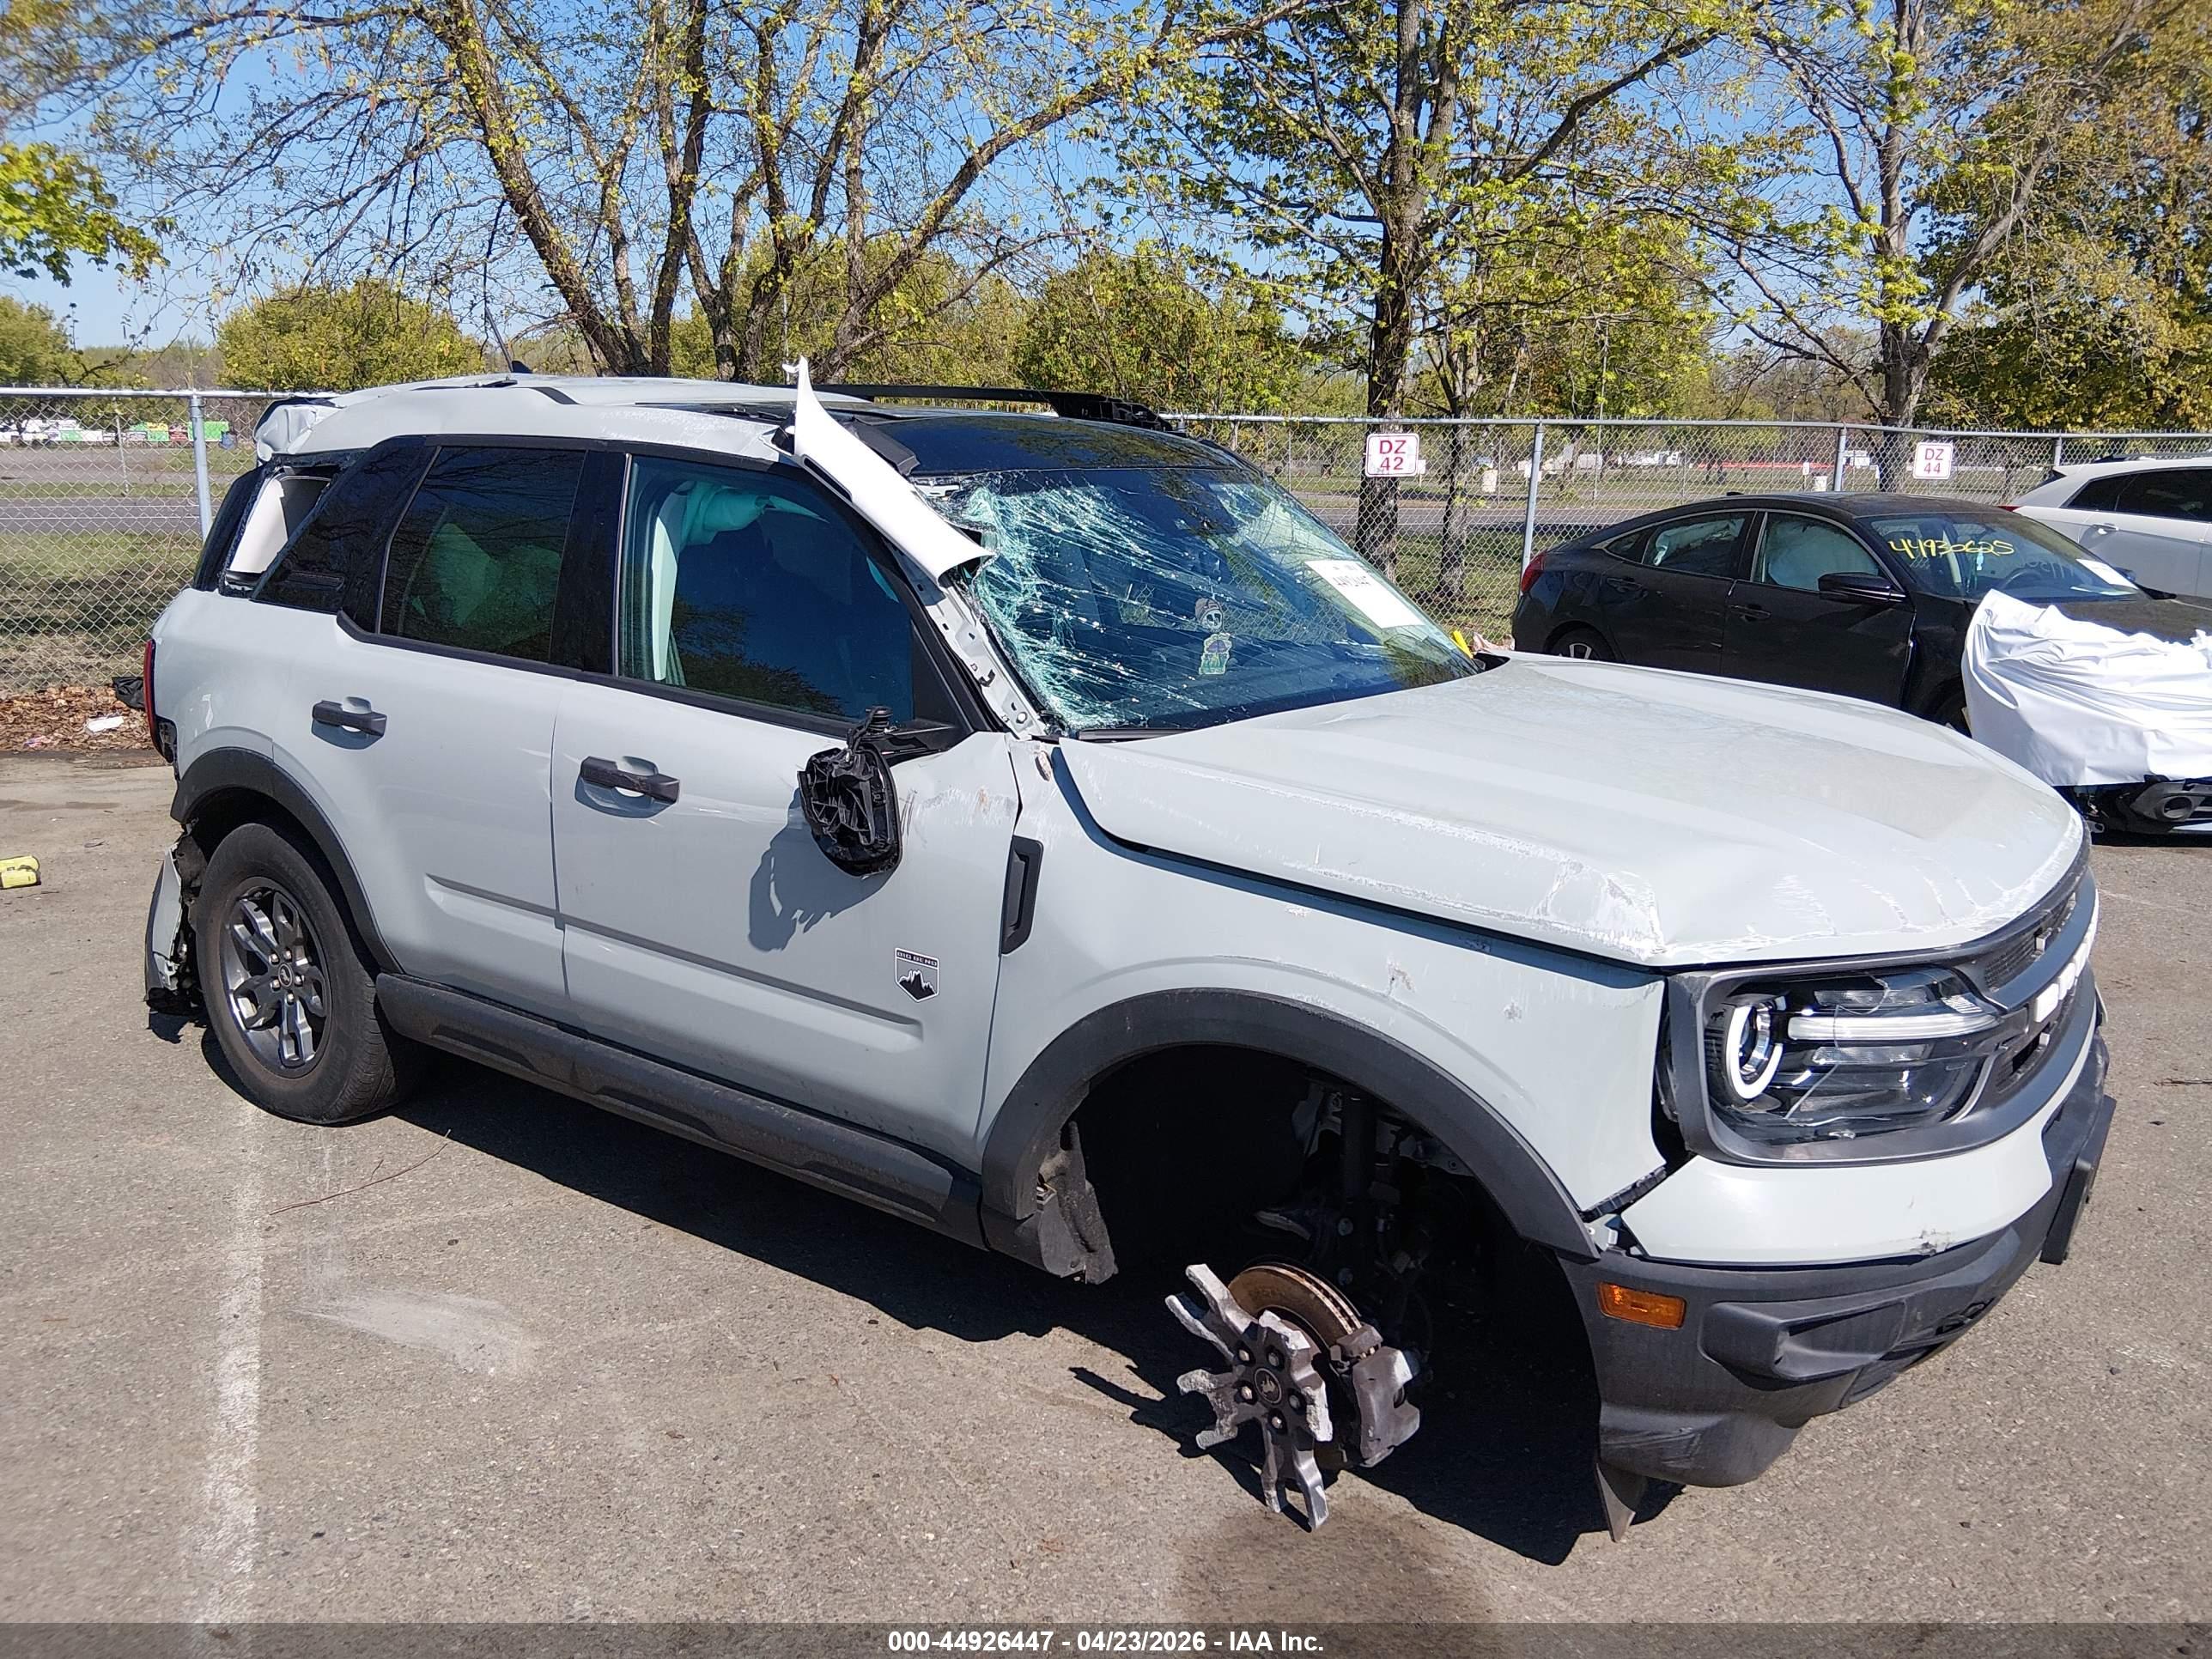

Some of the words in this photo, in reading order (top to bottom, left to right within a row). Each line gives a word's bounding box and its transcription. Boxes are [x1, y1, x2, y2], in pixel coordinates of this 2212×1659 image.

[1379, 440, 1407, 454] DZ
[1924, 447, 1944, 460] DZ
[1380, 457, 1404, 471] 42
[1923, 462, 1941, 474] 44
[1887, 538, 2014, 559] 44930625
